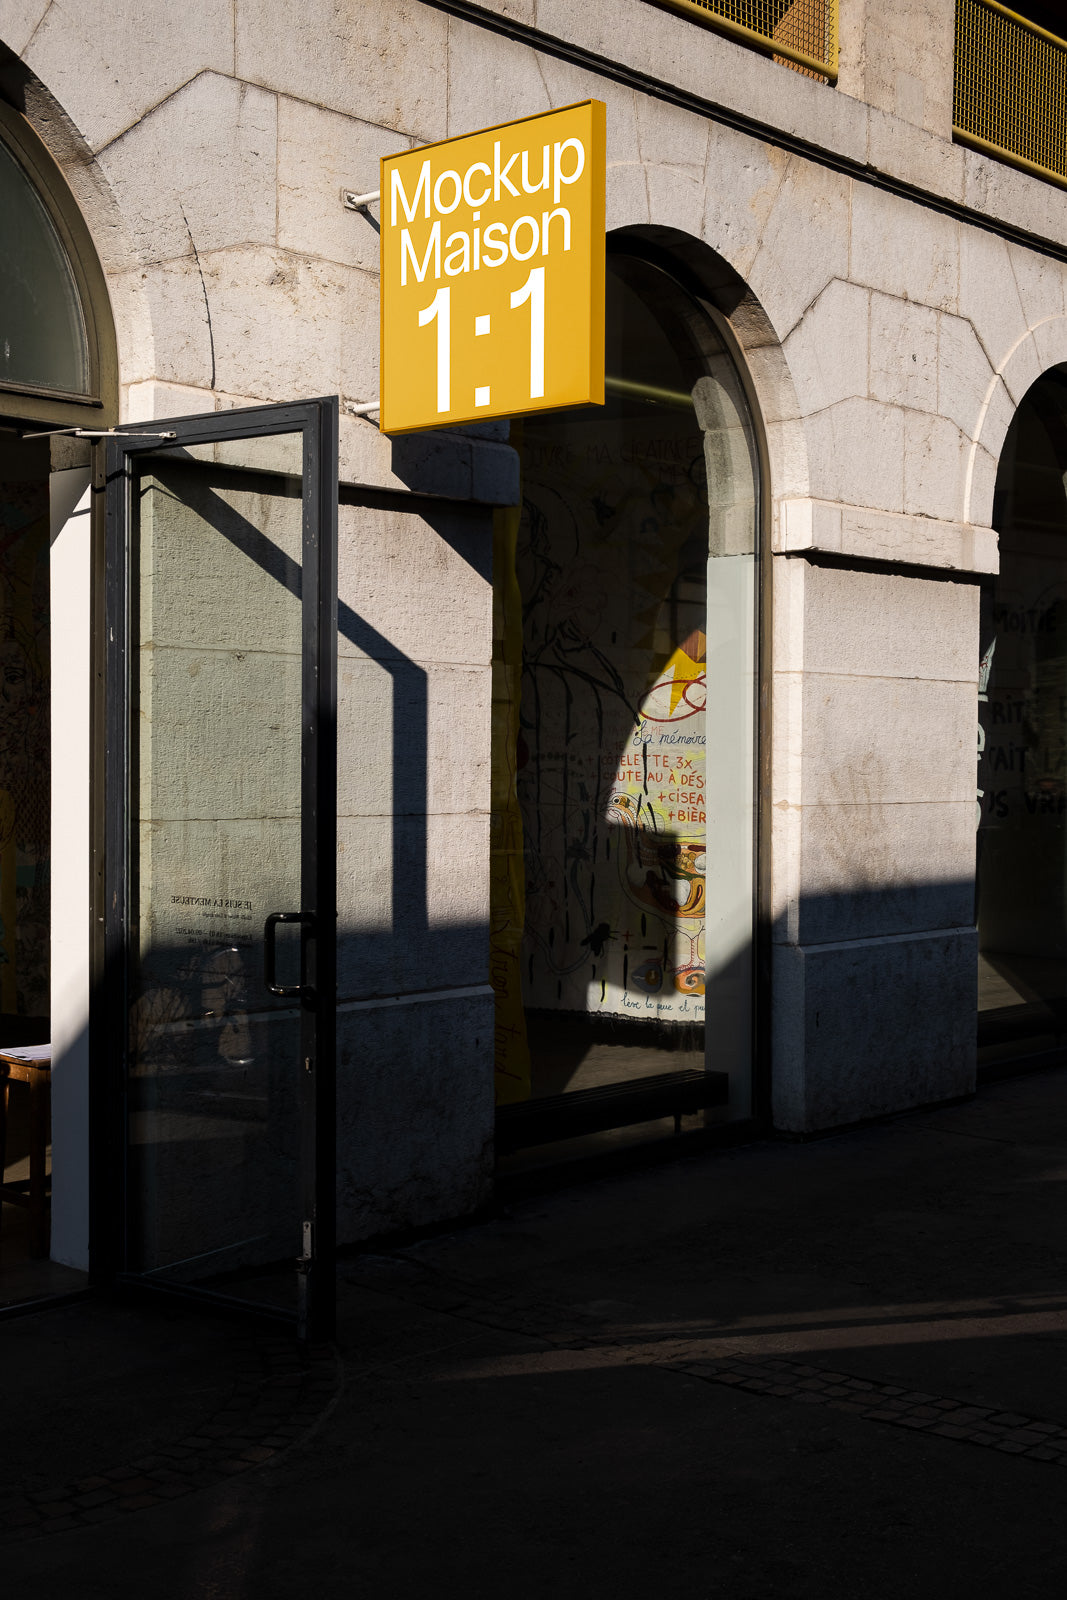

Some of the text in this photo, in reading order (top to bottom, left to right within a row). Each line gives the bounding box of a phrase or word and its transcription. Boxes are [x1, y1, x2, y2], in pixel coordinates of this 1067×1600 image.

[391, 136, 585, 228] Mockup
[401, 206, 571, 287] Maison
[418, 267, 545, 413] 1:1
[681, 770, 706, 789] DÉS
